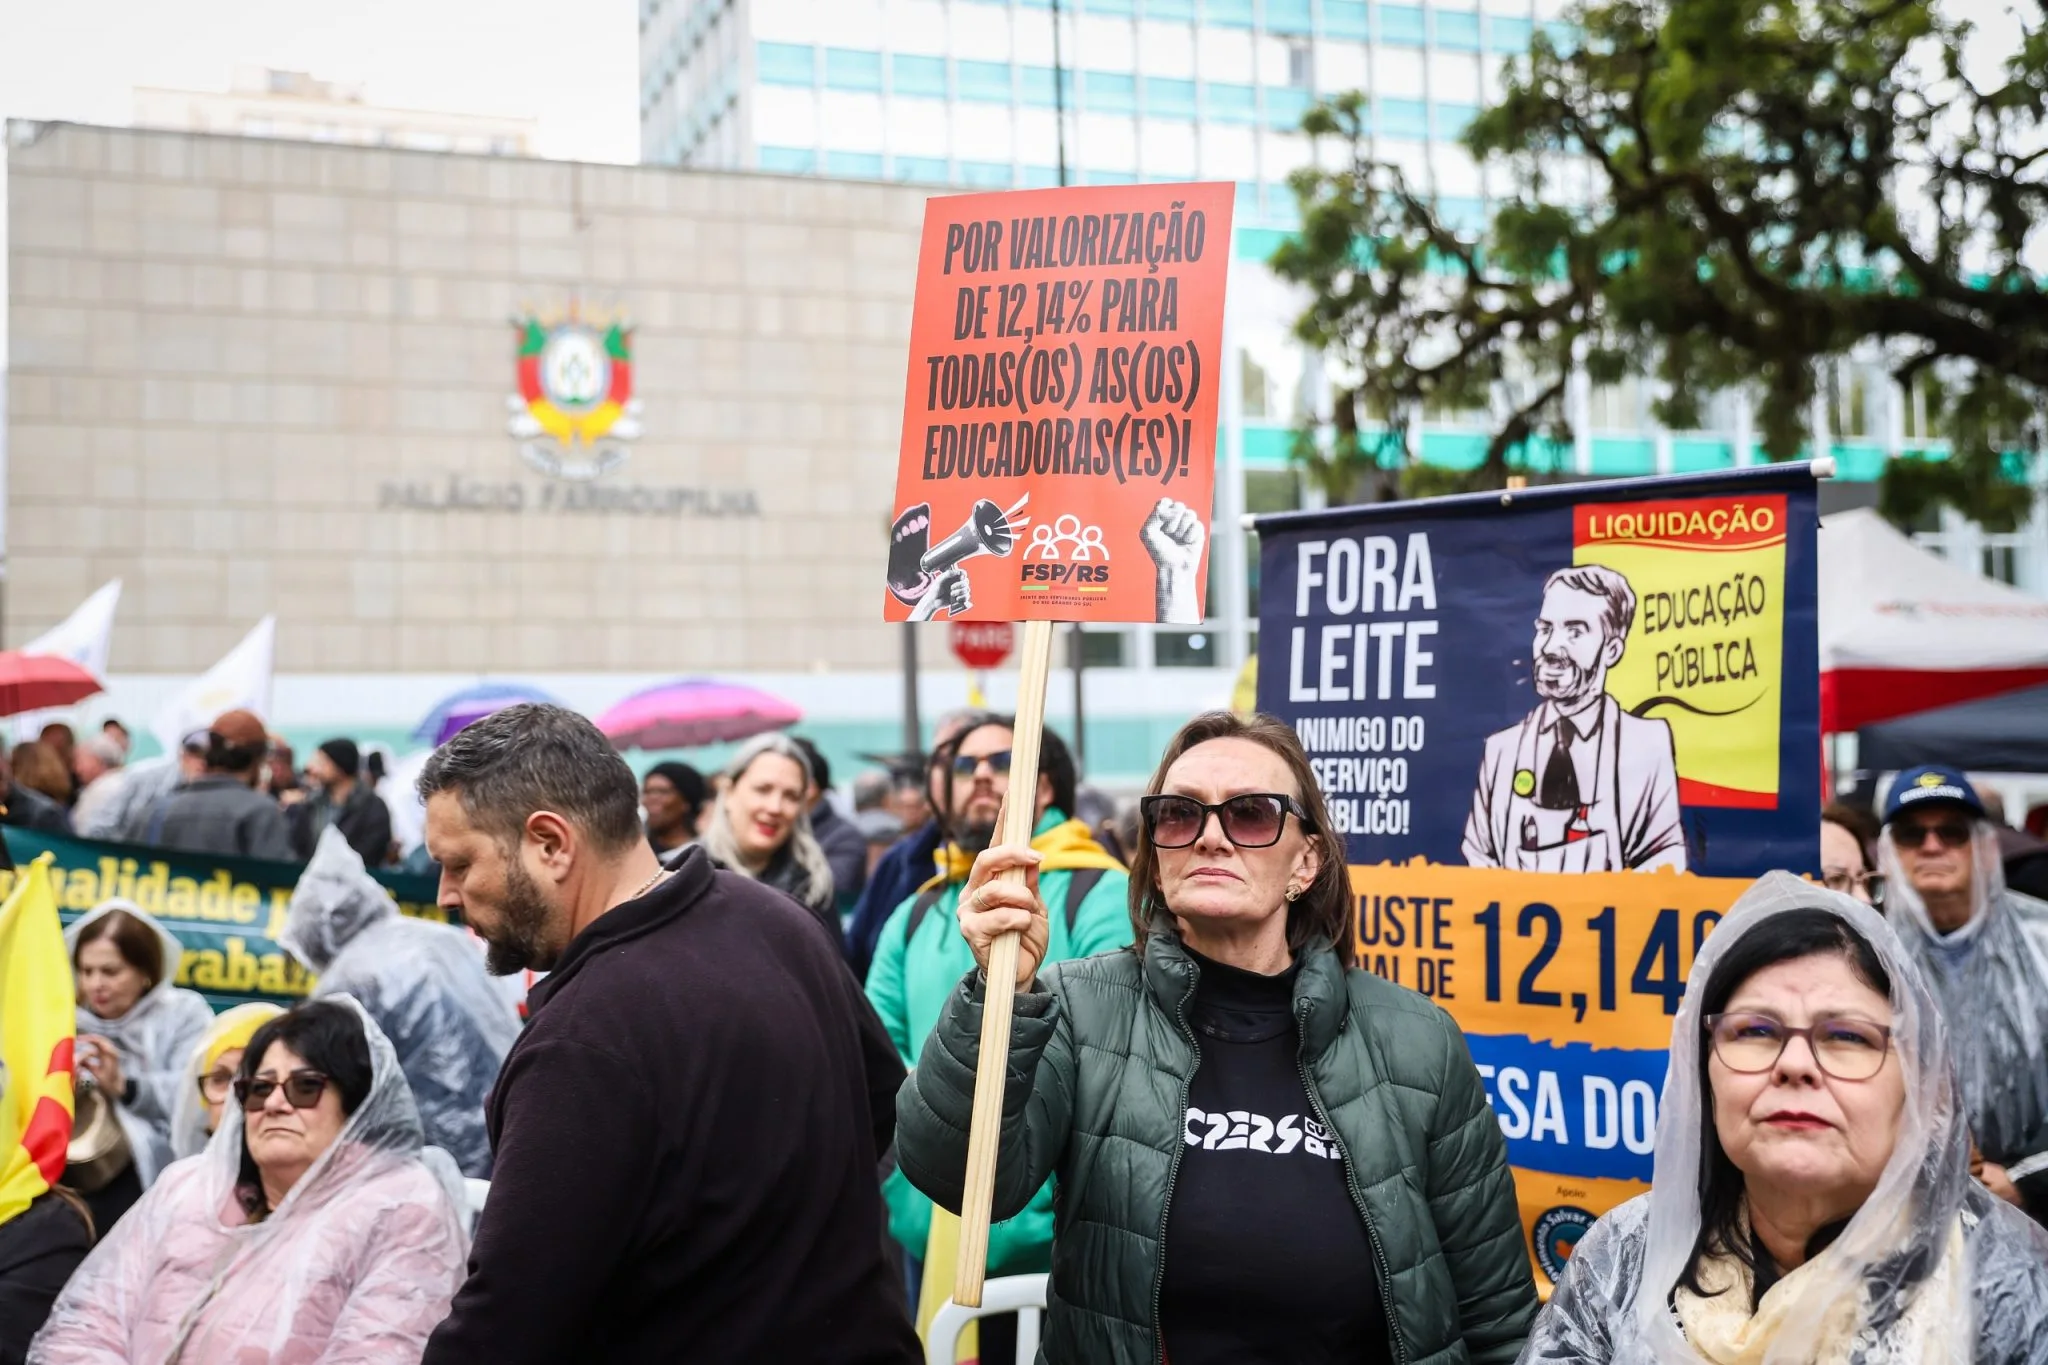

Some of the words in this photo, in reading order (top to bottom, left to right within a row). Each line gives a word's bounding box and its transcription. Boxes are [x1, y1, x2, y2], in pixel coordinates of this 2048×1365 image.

[943, 220, 1003, 275] POR
[1010, 200, 1206, 274] VALORIZAÇÃO
[954, 285, 991, 340] DE
[996, 279, 1093, 344] 12,14%
[1099, 277, 1178, 333] PARA
[926, 341, 1083, 415] TODAS(OS)
[1088, 340, 1201, 413] AS(OS)
[922, 412, 1192, 485] EDUCADORAS(ES)!
[1588, 504, 1775, 540] LIQUIDAÇÃO
[1020, 562, 1109, 584] FSP/RS
[1296, 531, 1438, 617] FORA
[1643, 573, 1765, 635] EDUCAÇÃO
[1288, 620, 1438, 702] LEITE
[1656, 638, 1758, 692] PÚBLICA
[1296, 716, 1387, 753] INIMIGO
[1391, 715, 1425, 752] DO
[1310, 757, 1409, 800] SERVIÇO
[1325, 792, 1411, 835] BLICO!
[1354, 894, 1454, 950] USTE
[1416, 956, 1456, 999] DE
[1184, 1107, 1303, 1154] CPERS
[1582, 1075, 1660, 1155] DO
